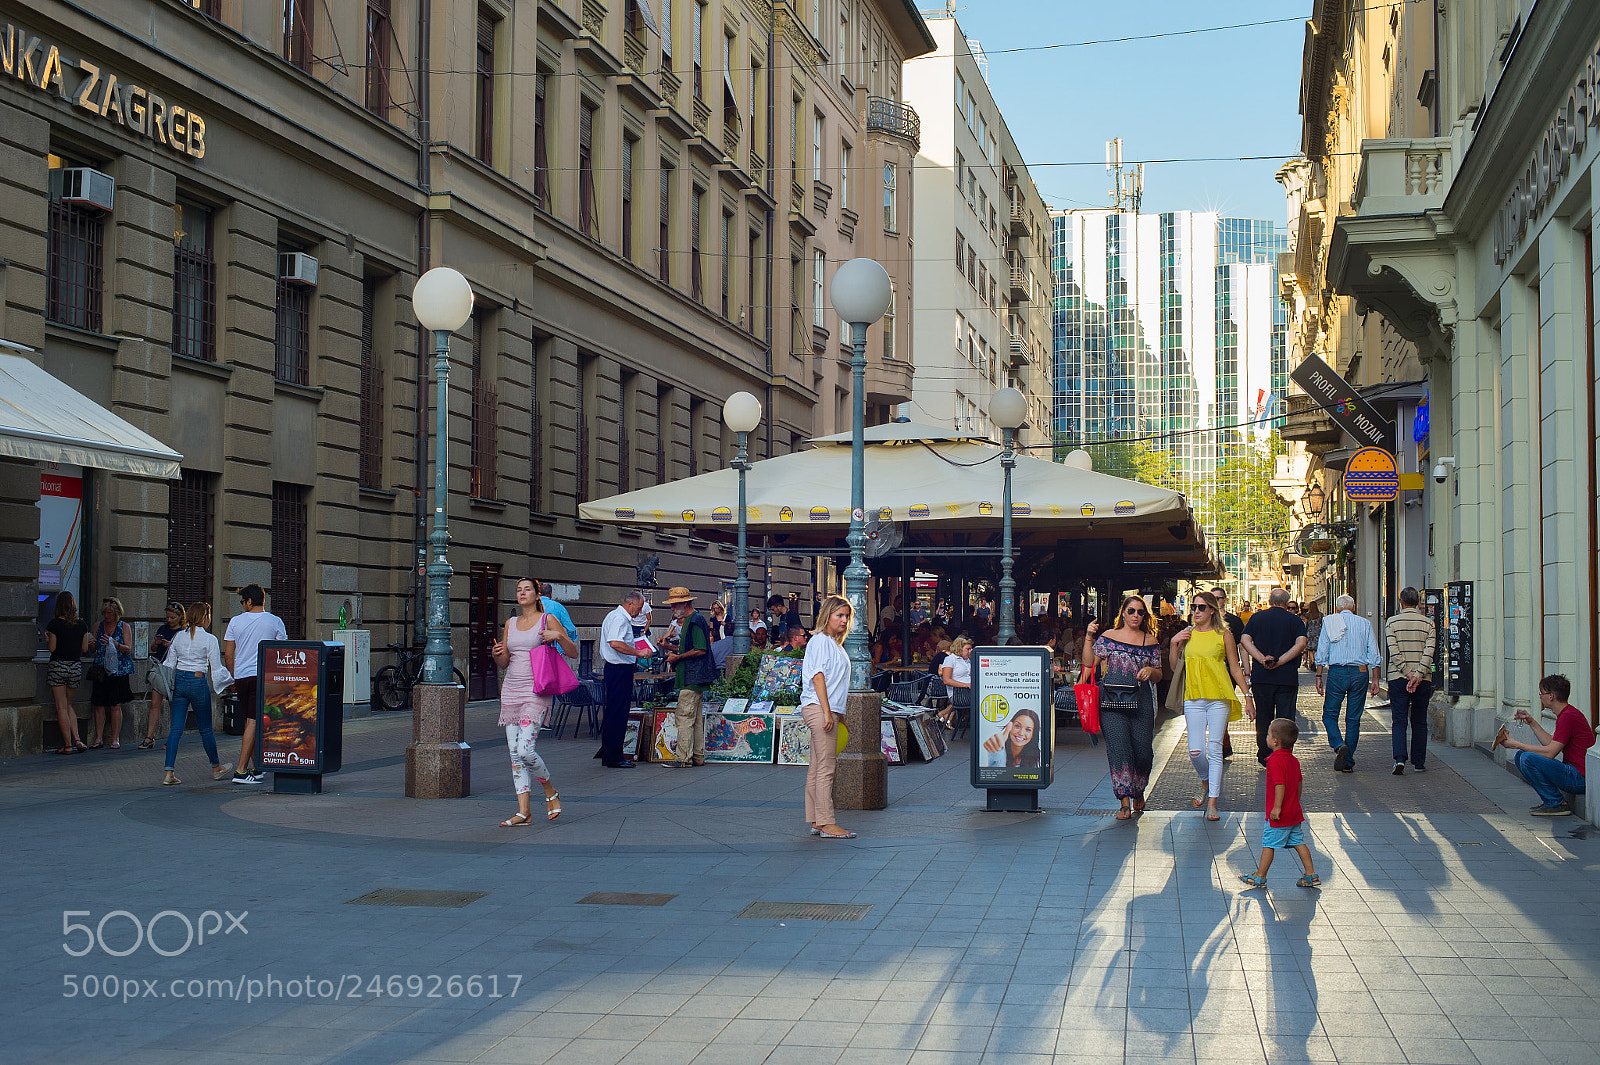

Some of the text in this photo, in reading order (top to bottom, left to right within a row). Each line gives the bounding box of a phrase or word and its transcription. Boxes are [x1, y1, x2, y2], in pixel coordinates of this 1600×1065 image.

[76, 59, 206, 159] ZAGREB
[1566, 72, 1587, 153] OF
[1309, 370, 1338, 400] PROFIL
[1353, 413, 1385, 445] MOZAIK
[276, 650, 300, 665] batak
[1013, 692, 1040, 700] 100m
